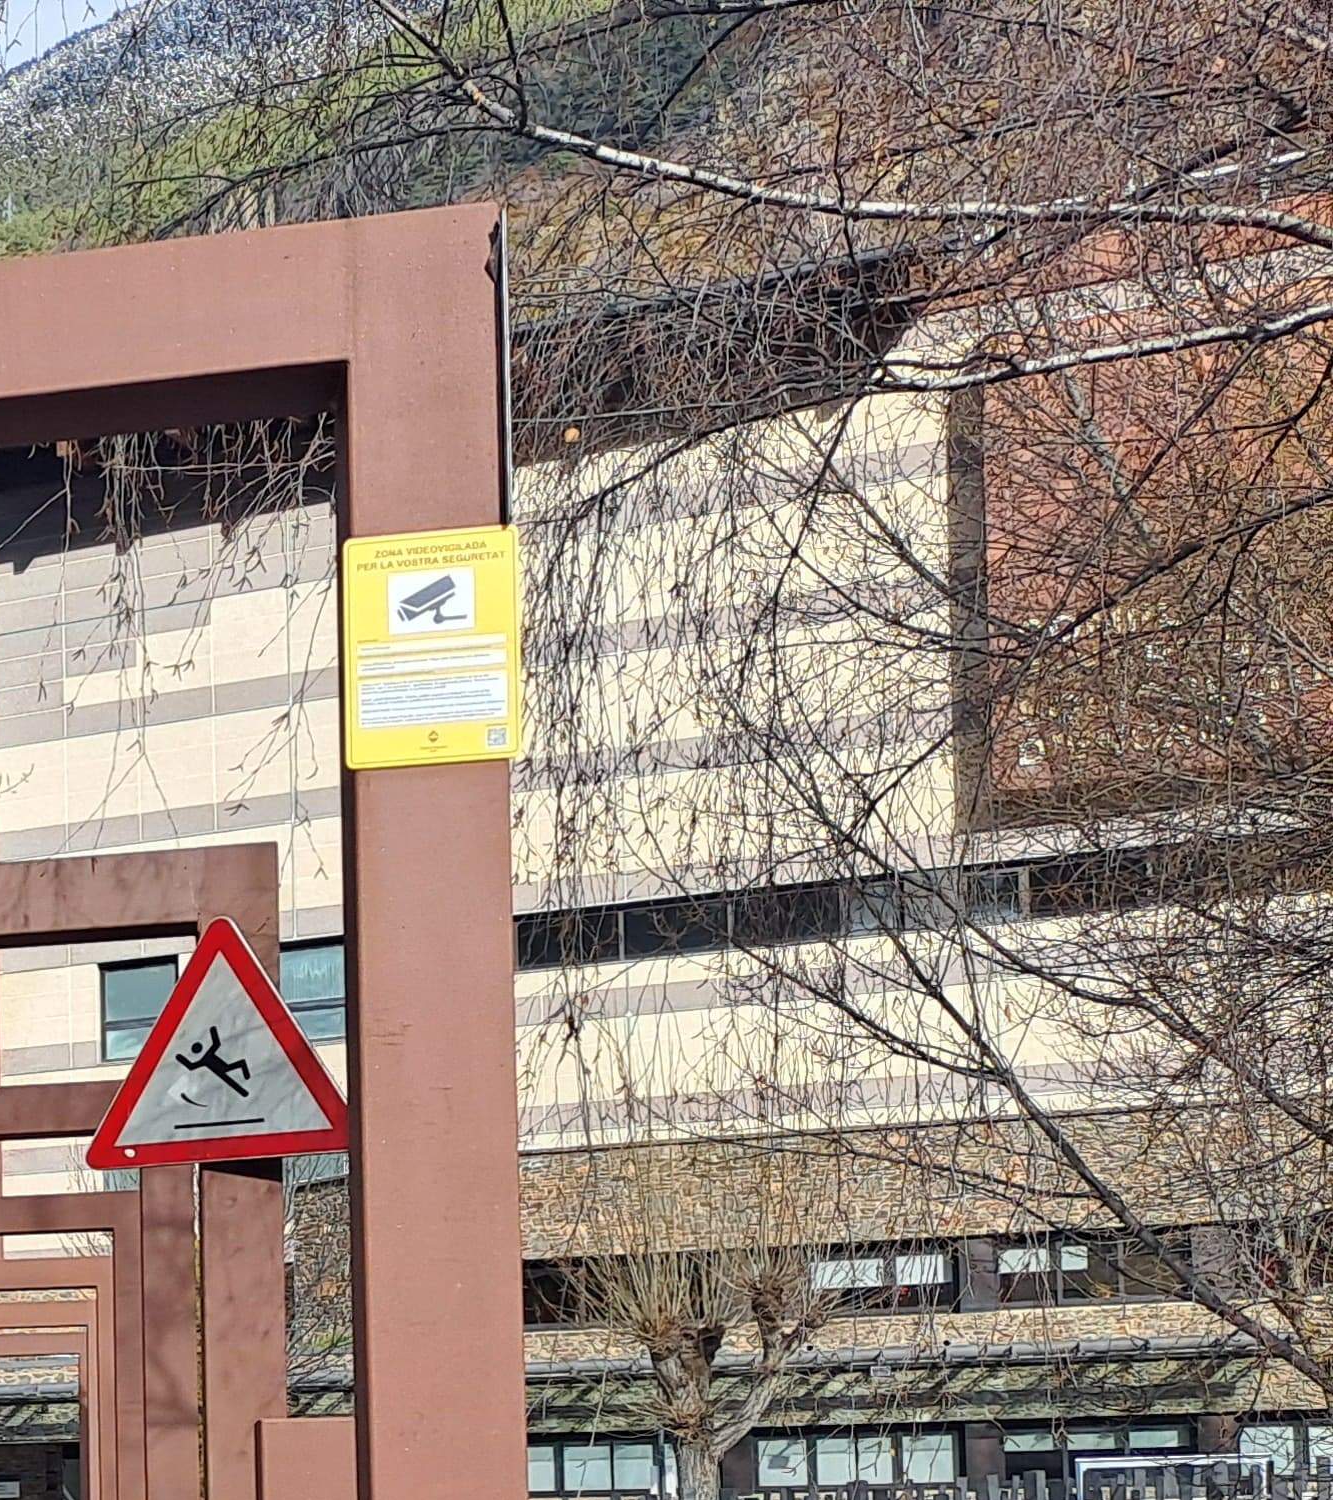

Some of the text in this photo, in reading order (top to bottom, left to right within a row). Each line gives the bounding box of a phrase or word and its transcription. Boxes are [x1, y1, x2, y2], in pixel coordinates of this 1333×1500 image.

[374, 540, 488, 559] ZONA VIDEOVIGILADA
[356, 550, 507, 572] PER LA VOSTRA SEGURETAT
